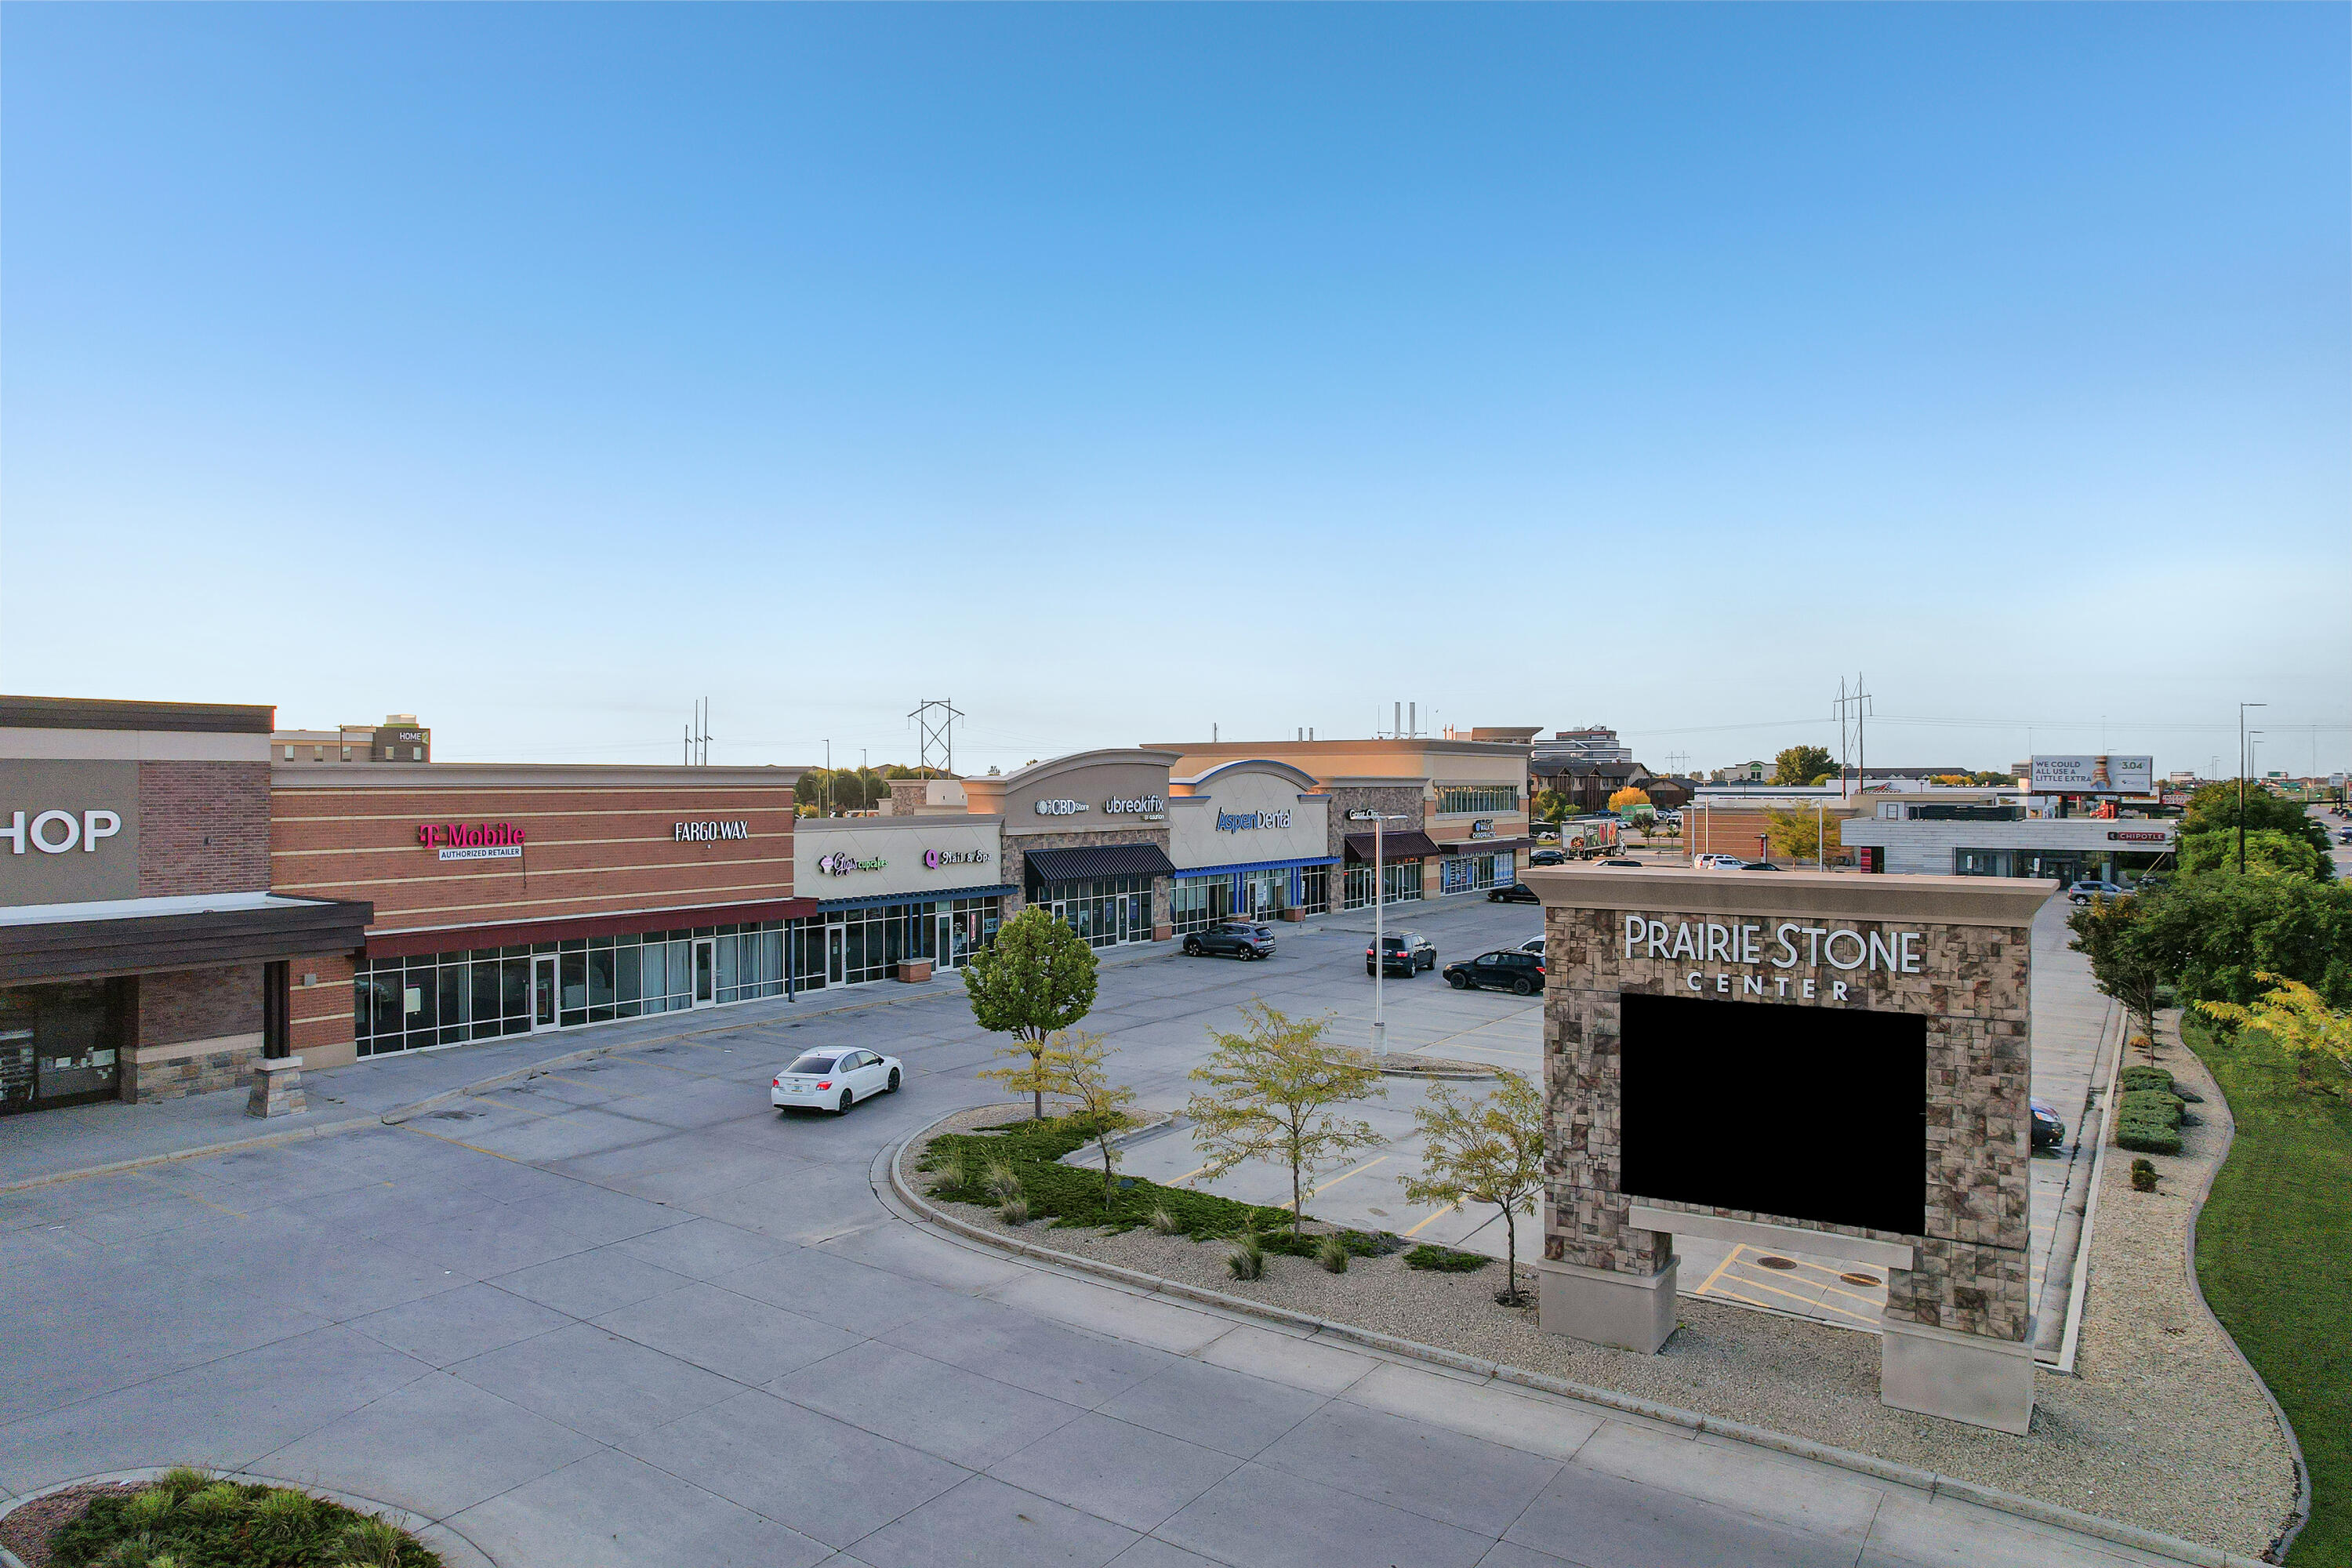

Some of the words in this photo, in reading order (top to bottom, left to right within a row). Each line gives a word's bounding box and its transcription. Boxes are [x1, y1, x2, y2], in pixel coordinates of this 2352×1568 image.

[1052, 799, 1076, 815] CBD
[1076, 802, 1090, 811] Store
[1106, 794, 1164, 814] ubreakifix
[446, 822, 526, 848] Mobile
[675, 821, 717, 842] FARGO
[720, 821, 748, 840] WAX
[441, 849, 486, 858] AUTHORIZED
[926, 849, 938, 869] Q
[942, 851, 963, 865] Nail
[967, 853, 973, 862] &
[976, 849, 992, 863] Spa
[858, 858, 889, 872] cupcakes
[1624, 915, 1761, 964] PRAIRIE
[1770, 923, 1921, 975] STONE
[1686, 971, 1849, 1002] CENTER
